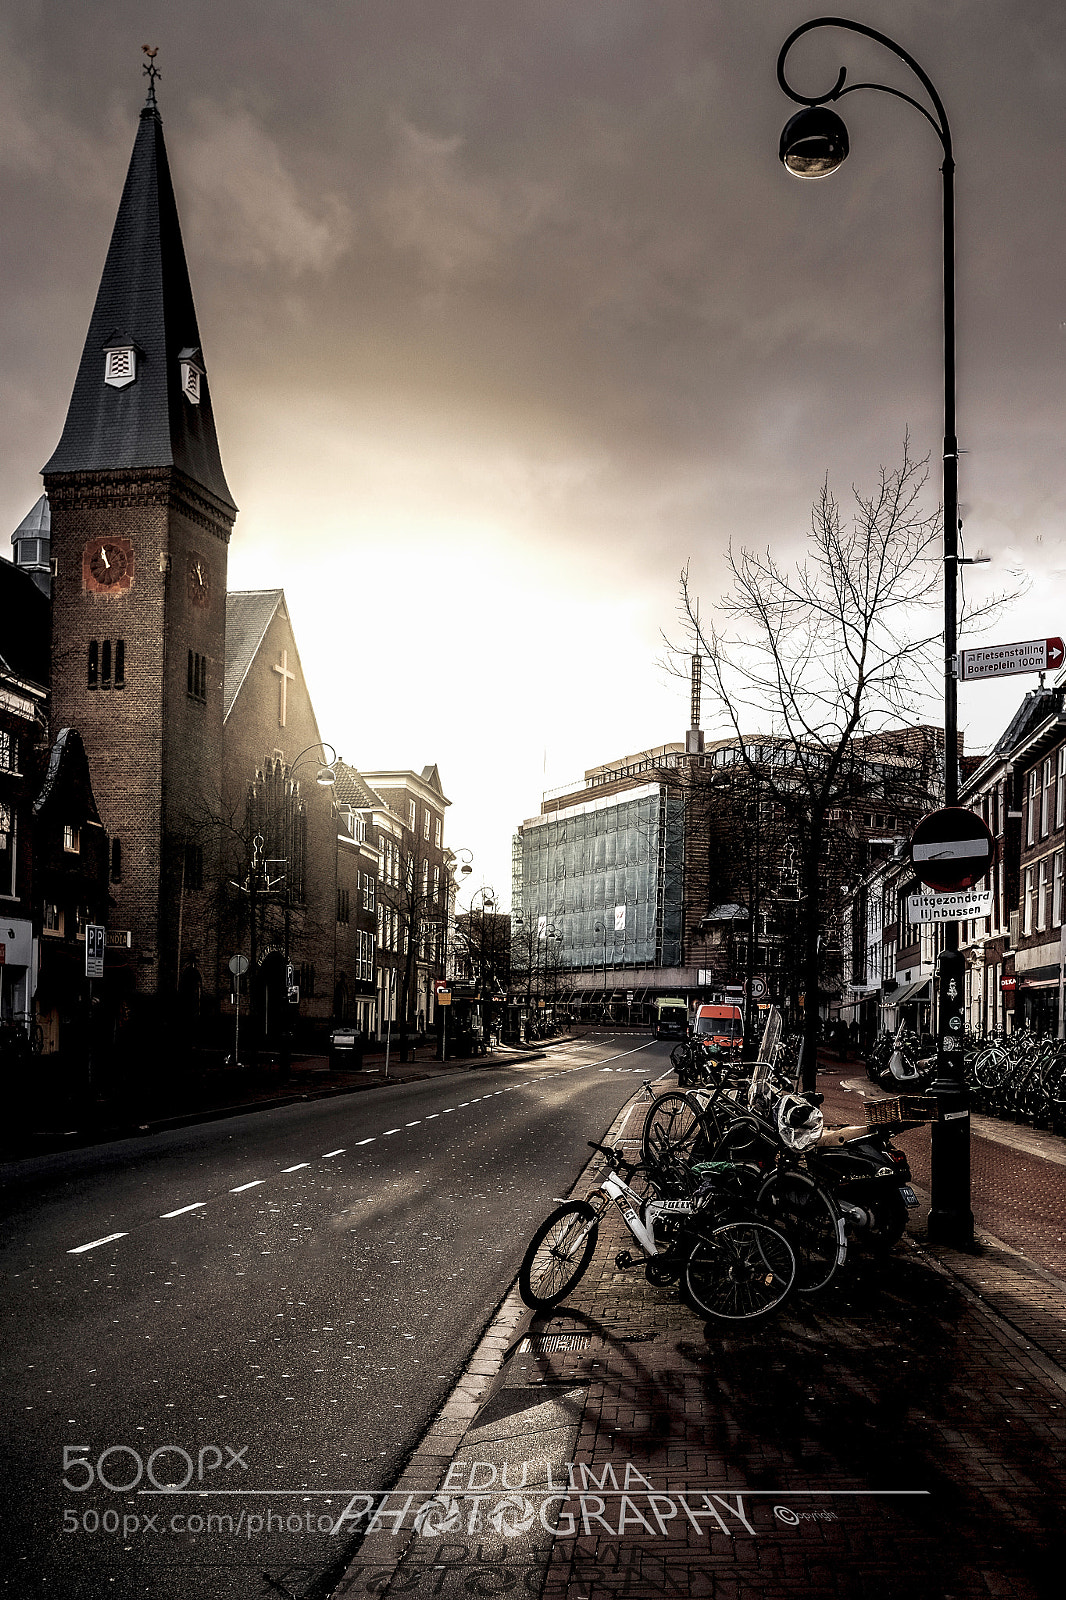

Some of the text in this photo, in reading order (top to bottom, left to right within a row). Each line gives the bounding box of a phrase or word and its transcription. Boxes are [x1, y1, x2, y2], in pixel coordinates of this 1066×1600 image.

[977, 645, 1044, 661] Fietsenstalling
[967, 657, 1044, 674] Boereplein 100m
[912, 891, 990, 909] uitgezonderd
[920, 905, 981, 921] lijnbussen
